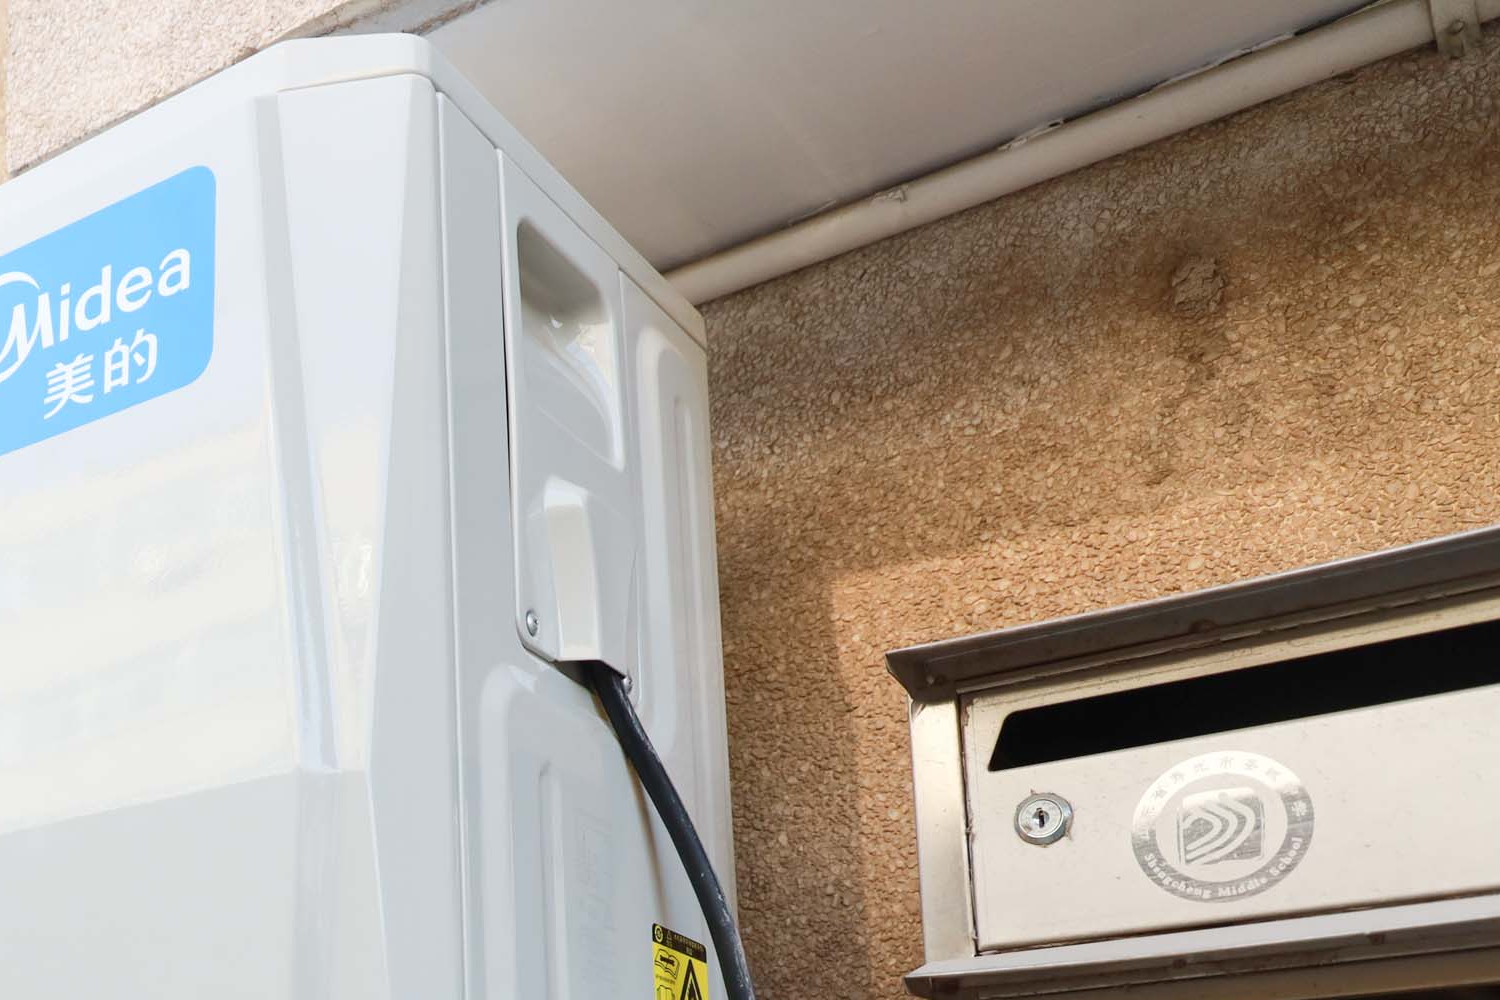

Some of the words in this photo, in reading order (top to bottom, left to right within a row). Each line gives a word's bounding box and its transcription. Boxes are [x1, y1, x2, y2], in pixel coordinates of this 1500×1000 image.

[43, 328, 158, 420] 美的
[1143, 852, 1213, 899] Shengcheng
[1217, 875, 1269, 897] Middle
[1269, 836, 1304, 878] School
